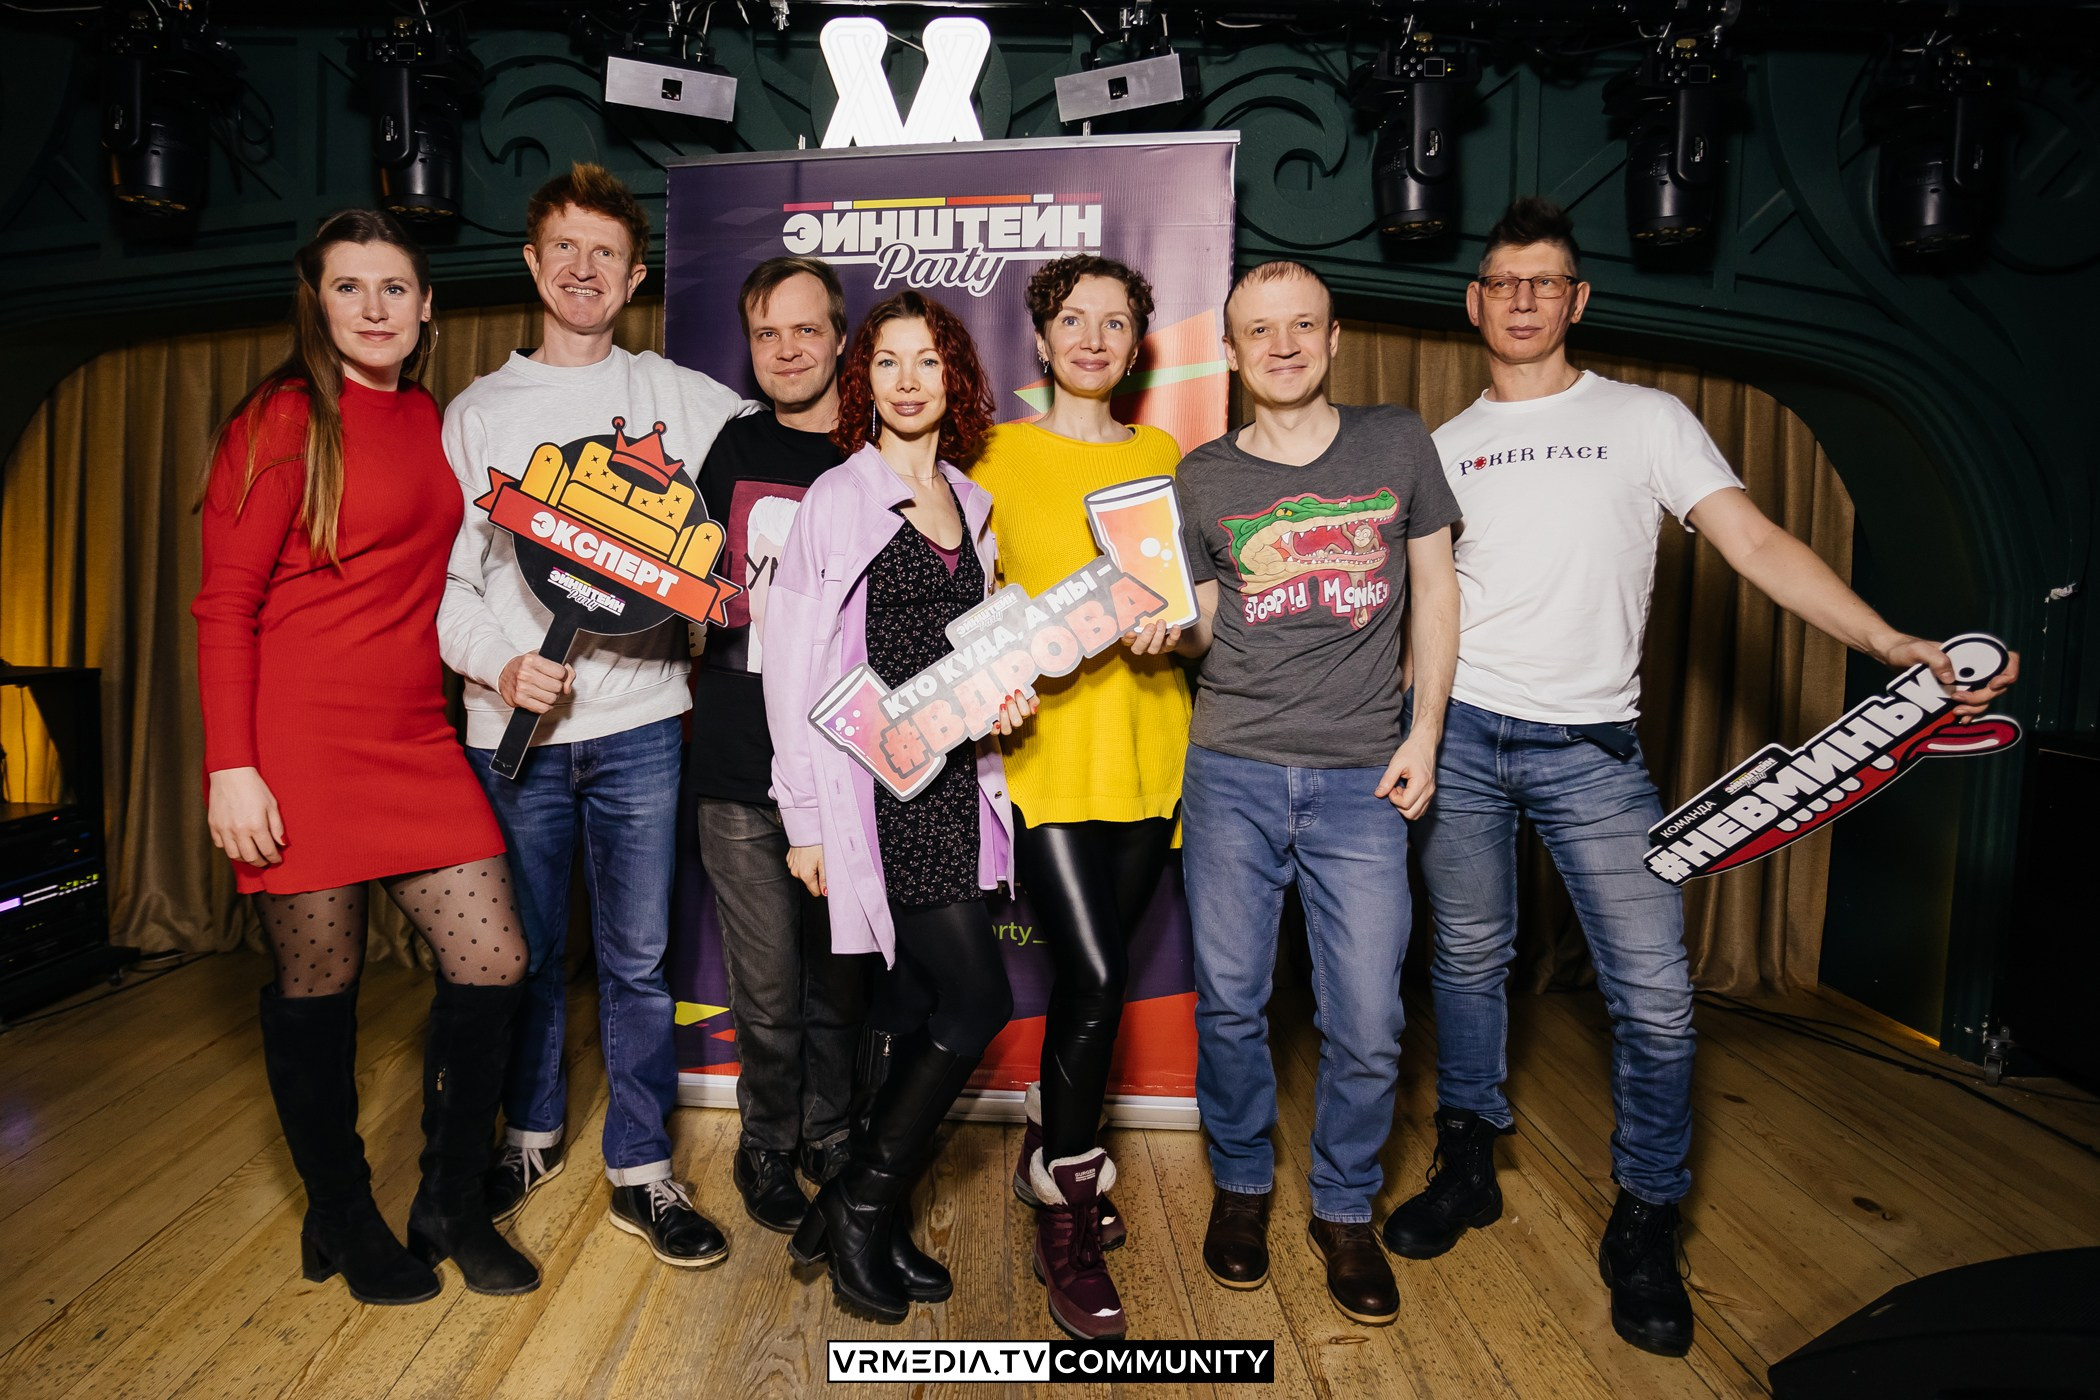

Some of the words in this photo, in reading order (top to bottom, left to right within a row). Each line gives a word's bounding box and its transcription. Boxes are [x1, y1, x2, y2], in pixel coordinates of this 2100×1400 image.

[782, 194, 1101, 255] ЭЙНШТЕЙН
[874, 242, 1006, 297] Party
[1546, 446, 1608, 460] FACE
[530, 511, 679, 597] ЭКСПЕРТ
[549, 571, 626, 614] ЭЙНШТЕЙН
[882, 674, 937, 719] КТО
[941, 626, 1023, 685] КУДА,
[1024, 604, 1049, 630] А
[1045, 571, 1098, 614] МЫ
[1660, 799, 1717, 838] КОМАНДА
